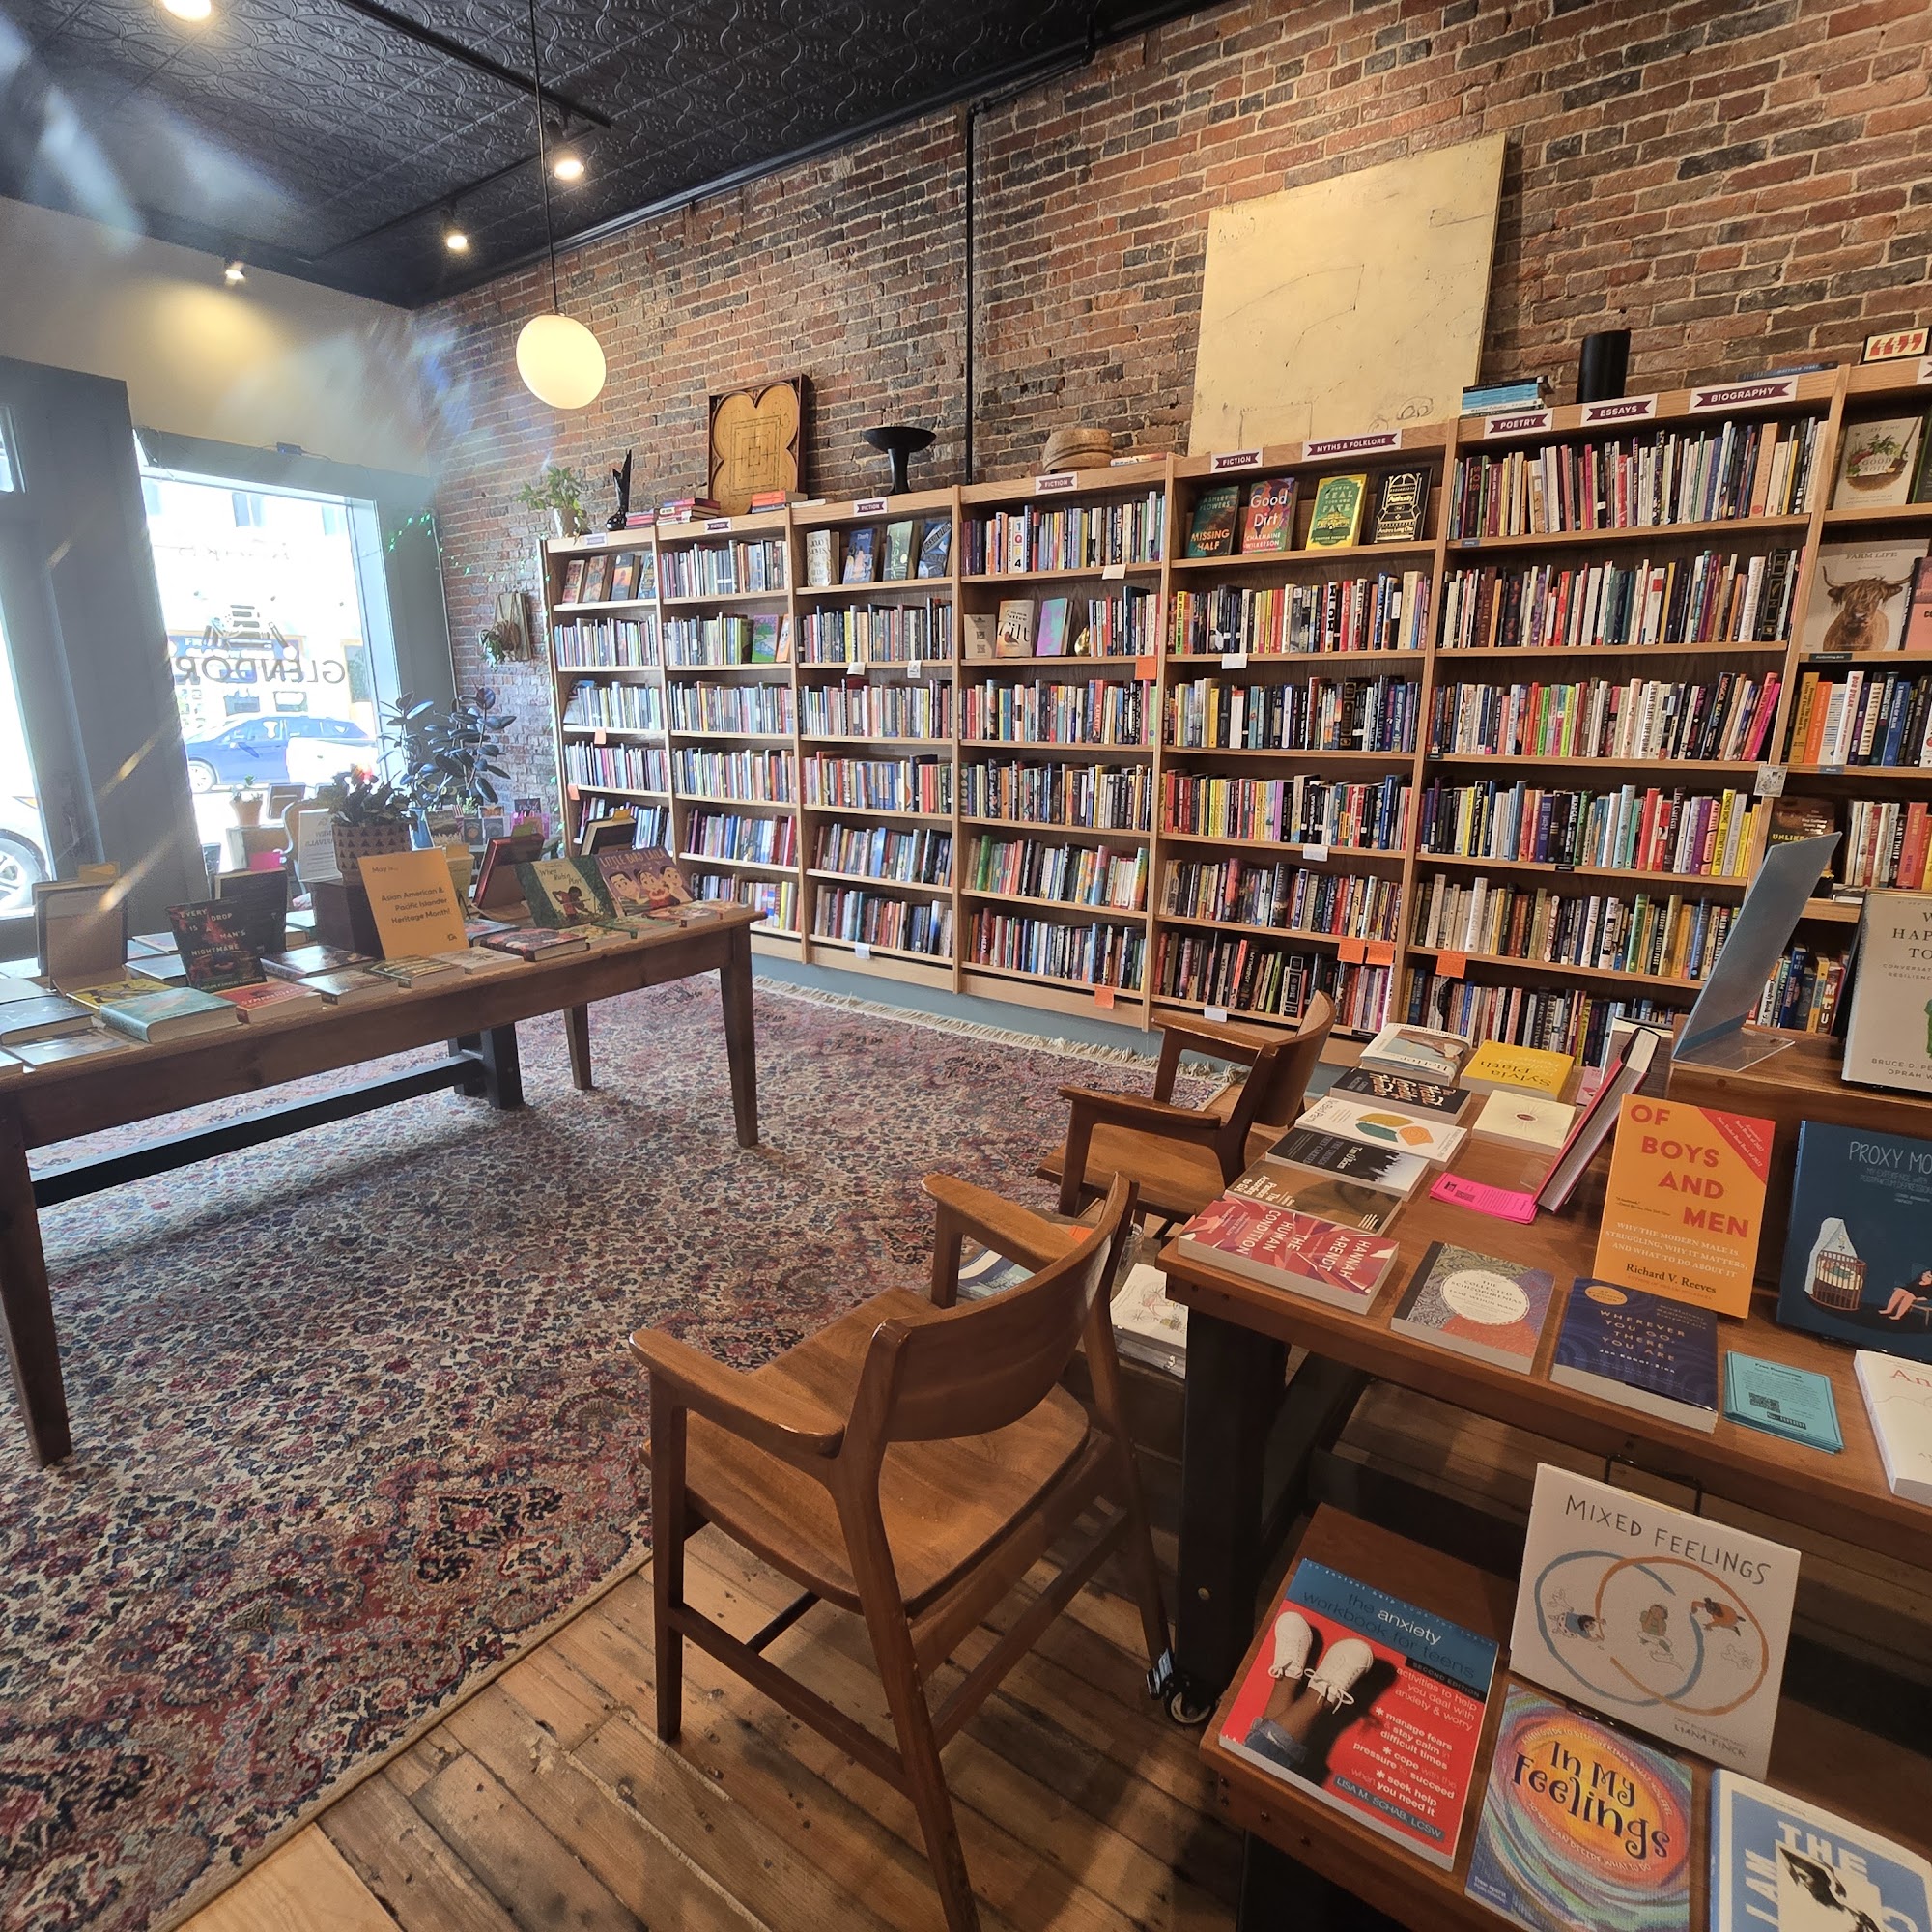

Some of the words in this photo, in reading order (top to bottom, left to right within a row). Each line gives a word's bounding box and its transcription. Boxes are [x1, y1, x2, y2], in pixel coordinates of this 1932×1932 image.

[1711, 386, 1775, 403] BIOGRAPHY
[1600, 405, 1637, 417] ESSAYS
[1499, 417, 1537, 430] POETRY
[1317, 442, 1341, 453] MYTHS
[1350, 438, 1386, 449] FOLKLORE
[1222, 456, 1251, 467] FICTION
[1862, 457, 1891, 466] GOOD
[1199, 501, 1231, 510] FLOWERS
[1250, 489, 1288, 508] Good
[1324, 491, 1352, 499] SEAL
[1322, 503, 1350, 512] FATE
[1254, 513, 1278, 527] Dirt
[1191, 529, 1230, 540] MISSING
[1197, 541, 1219, 551] HALF
[1242, 540, 1280, 549] WILKERSON
[1245, 532, 1281, 541] CHARMAINE
[1670, 805, 1681, 829] Garten
[599, 855, 625, 867] LITTLE
[626, 852, 644, 864] BIRD
[645, 848, 667, 860] LAILA
[539, 868, 557, 877] When
[381, 894, 402, 902] Asian
[404, 888, 437, 899] American
[395, 902, 418, 912] Pacific
[419, 897, 448, 909] Islander
[179, 908, 208, 919] EVERY
[211, 913, 233, 922] DROP
[391, 913, 424, 924] Heritage
[425, 908, 450, 919] Month!
[220, 929, 246, 940] MAN'S
[191, 943, 240, 955] NIGHTMARE
[1480, 1060, 1530, 1074] Plath
[1871, 1058, 1904, 1067] BRUCE
[1888, 1068, 1921, 1078] OPRAH
[1491, 1070, 1552, 1087] Sylvia
[1630, 1104, 1670, 1126] OF
[1641, 1135, 1719, 1167] BOYS
[1849, 1141, 1904, 1169] PROXY
[1909, 1151, 1932, 1175] MO
[1658, 1170, 1725, 1199] AND
[1236, 1210, 1281, 1255] CONDITION
[1683, 1207, 1749, 1238] MEN
[1263, 1221, 1294, 1252] HUMAN
[1289, 1235, 1308, 1251] THE
[1617, 1221, 1639, 1232] WHY
[1640, 1227, 1659, 1237] THE
[1660, 1231, 1698, 1246] MODERN
[1699, 1240, 1728, 1254] MALE
[1319, 1236, 1350, 1272] ARENDT
[1339, 1240, 1371, 1279] HANNAH
[1605, 1230, 1662, 1250] STRUGGLING,
[1663, 1244, 1687, 1255] WHY
[1700, 1252, 1748, 1271] MATTERS,
[1612, 1242, 1633, 1253] AND
[1633, 1247, 1662, 1259] WHAT
[1662, 1254, 1675, 1263] TO
[1677, 1258, 1690, 1266] DO
[1691, 1262, 1723, 1274] ABOUT
[1464, 1280, 1513, 1296] COLLECTED
[1626, 1264, 1665, 1281] Richard
[1668, 1274, 1678, 1285] V.
[1681, 1276, 1717, 1293] Reeves
[1451, 1281, 1522, 1304] SCHIZOPHRENIAS
[1600, 1309, 1686, 1337] WHEREVER
[1605, 1320, 1636, 1332] YOU
[1602, 1337, 1634, 1350] YOU
[1644, 1349, 1675, 1362] ARE
[1614, 1330, 1664, 1350] THERE
[1565, 1494, 1642, 1537] MIXED
[1654, 1528, 1772, 1586] FEELINGS
[1347, 1593, 1375, 1614] the
[1378, 1609, 1442, 1646] anxiety
[1302, 1591, 1387, 1637] workbook
[1392, 1632, 1416, 1651] for
[1422, 1645, 1475, 1680] teens
[1396, 1667, 1439, 1691] activities
[1441, 1689, 1452, 1699] to
[1454, 1692, 1478, 1712] help
[1412, 1662, 1445, 1681] SECOND
[1448, 1678, 1480, 1698] EDITION
[1394, 1689, 1432, 1711] anxiety
[1433, 1706, 1440, 1716] &
[1443, 1712, 1473, 1732] worry
[1407, 1684, 1427, 1698] you
[1429, 1693, 1452, 1709] deal
[1453, 1705, 1475, 1720] with
[1385, 1712, 1425, 1737] manage
[1427, 1731, 1453, 1751] fears
[1392, 1725, 1414, 1742] stay
[1415, 1737, 1440, 1755] calm
[1674, 1724, 1707, 1742] LIANA
[1711, 1736, 1747, 1758] FINCK
[1380, 1730, 1418, 1754] difficult
[1419, 1749, 1448, 1770] times
[1394, 1752, 1420, 1771] cope
[1353, 1742, 1398, 1770] pressure
[1409, 1772, 1455, 1799] succeed
[1549, 1740, 1582, 1778] In
[1591, 1760, 1635, 1808] My
[1377, 1781, 1397, 1798] you
[1398, 1792, 1426, 1812] need
[1427, 1807, 1435, 1817] it
[1387, 1775, 1412, 1793] seek
[1413, 1787, 1437, 1806] help
[1336, 1777, 1357, 1792] LISA
[1357, 1788, 1369, 1801] M.
[1372, 1796, 1408, 1822] SCHAB,
[1410, 1815, 1442, 1838] LCSW
[1511, 1751, 1671, 1861] Feelings
[1570, 1839, 1602, 1863] DECIDE
[1604, 1859, 1628, 1872] WHAT
[1777, 1820, 1868, 1877] THE
